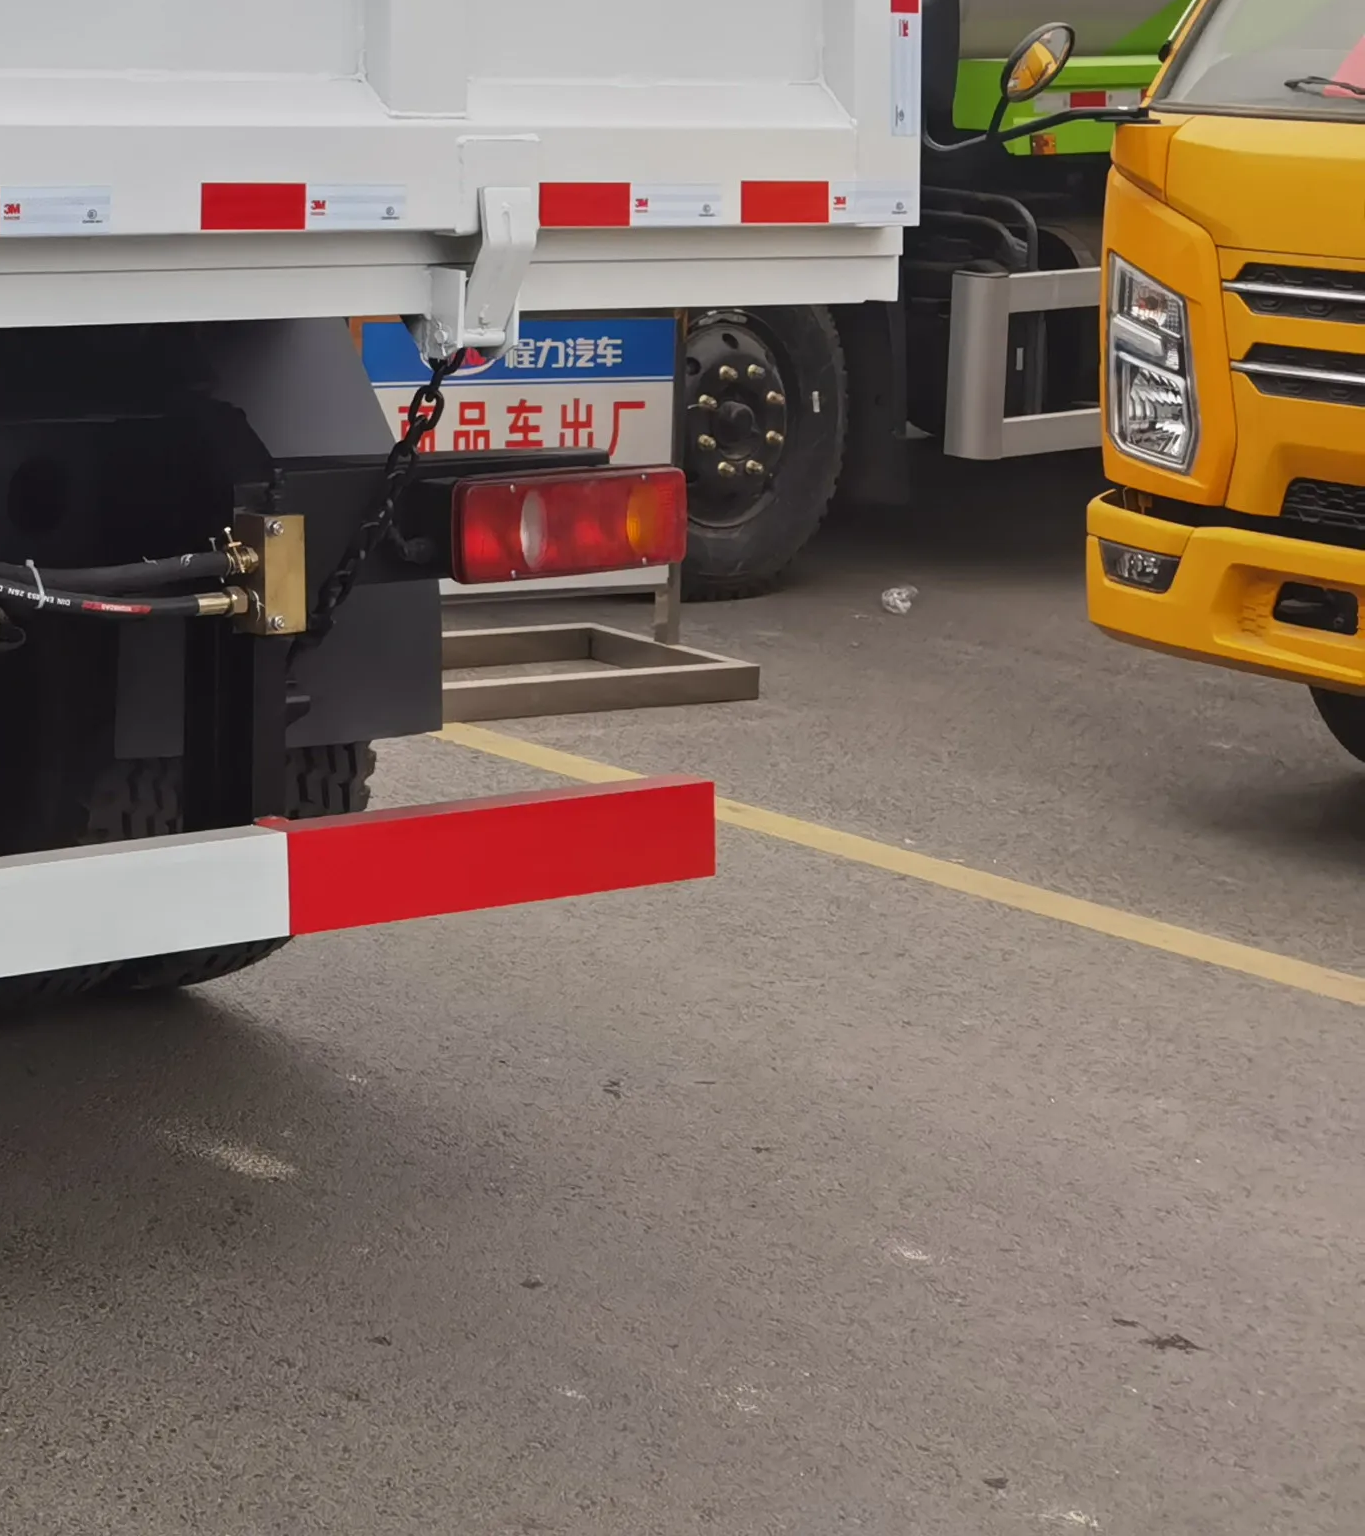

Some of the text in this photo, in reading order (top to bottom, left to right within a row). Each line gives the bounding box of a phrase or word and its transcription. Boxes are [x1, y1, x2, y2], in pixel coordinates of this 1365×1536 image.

[4, 204, 21, 215] 3M
[311, 200, 326, 212] 3M
[505, 337, 623, 369] 程力汽车
[57, 597, 71, 606] DIN
